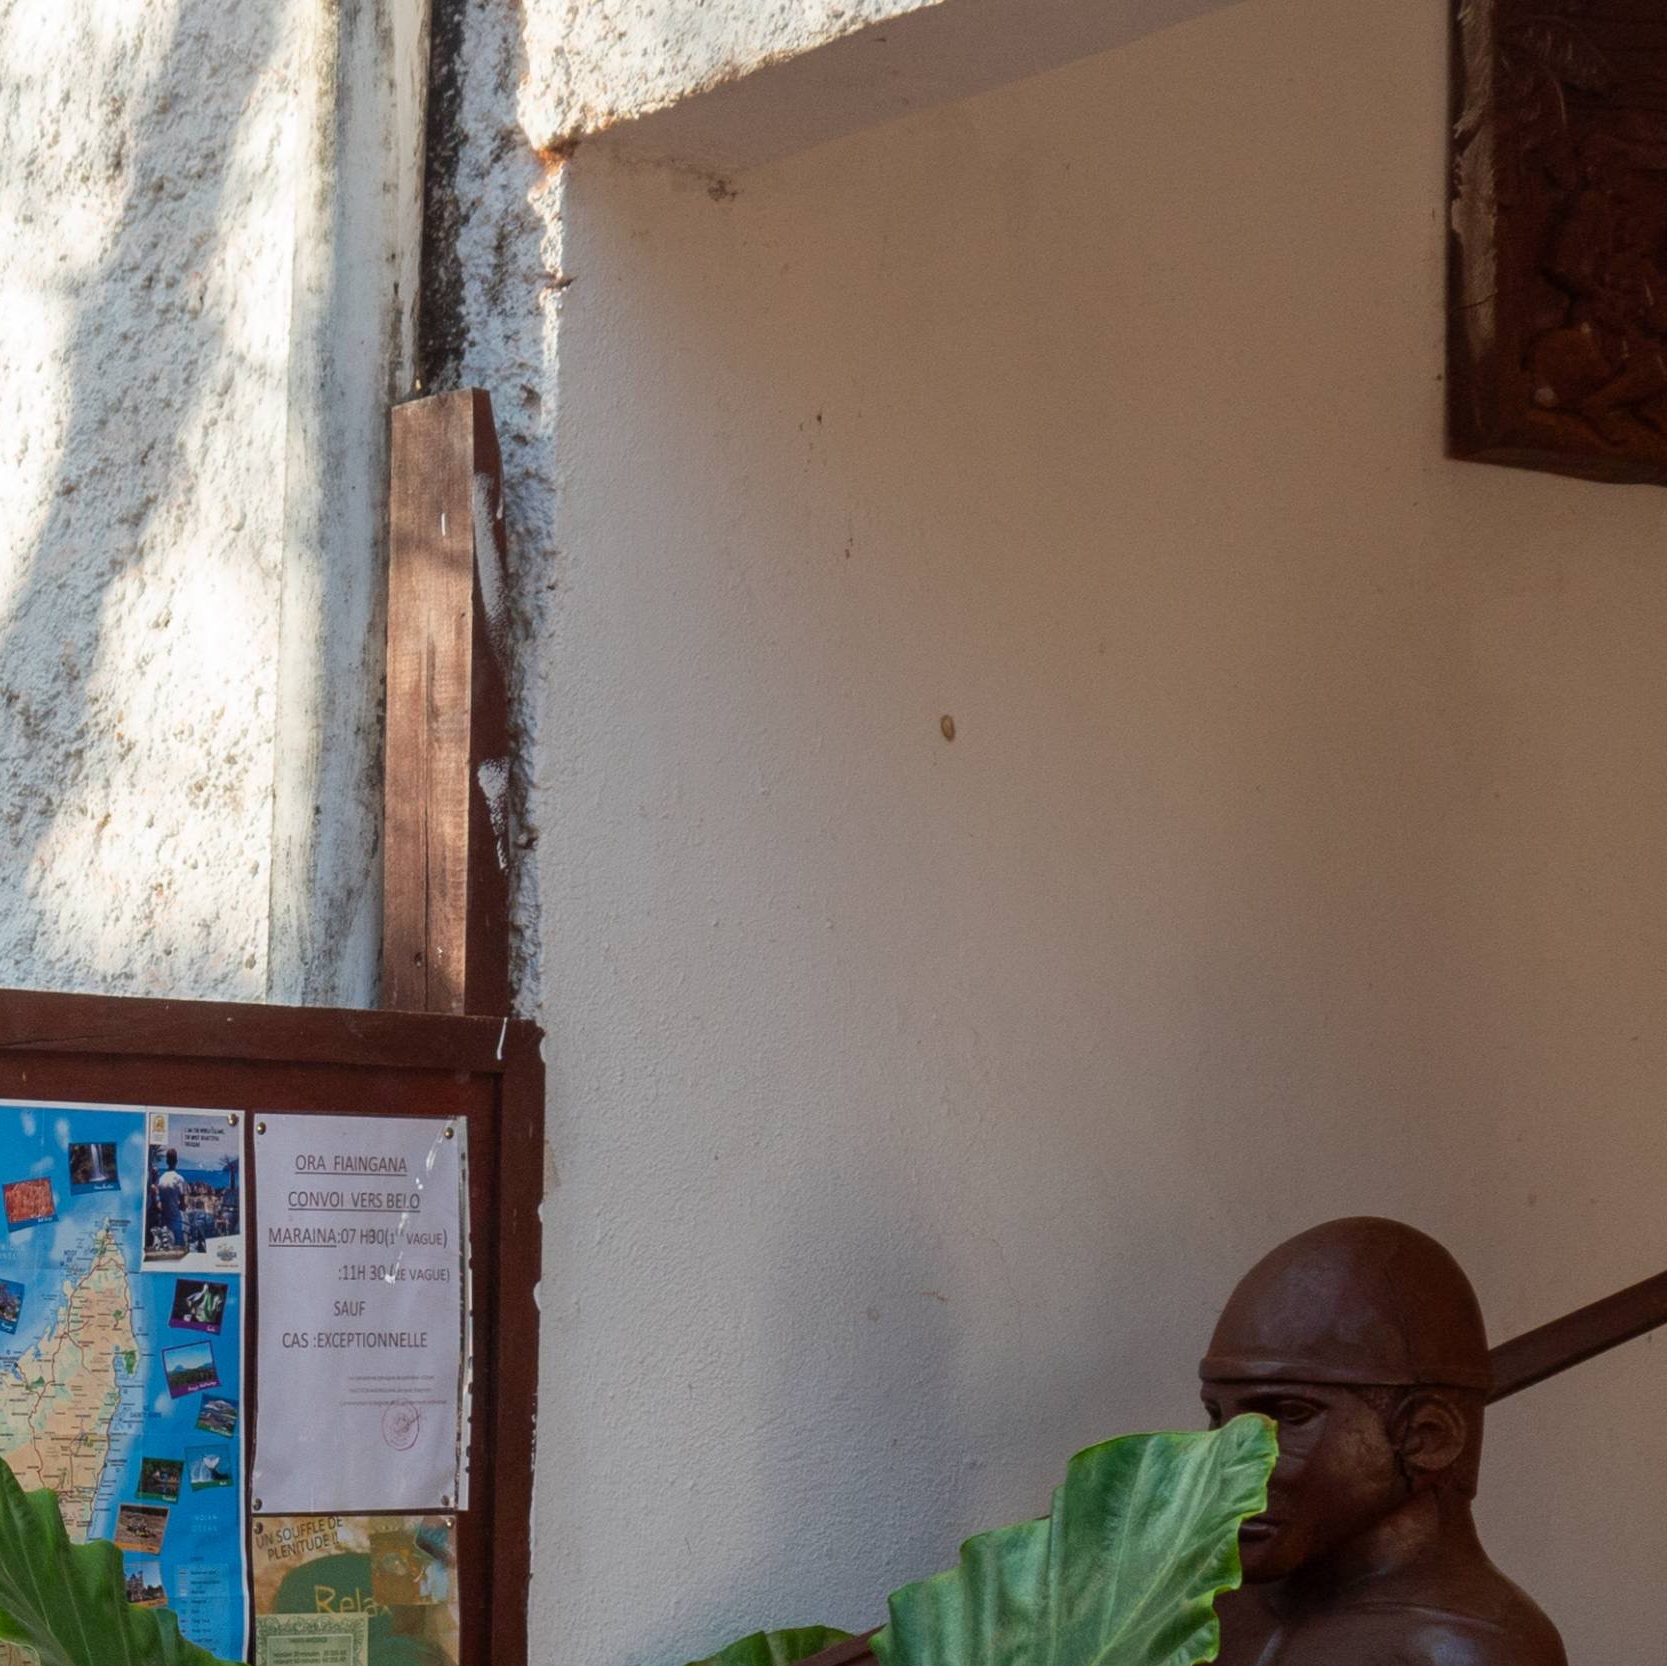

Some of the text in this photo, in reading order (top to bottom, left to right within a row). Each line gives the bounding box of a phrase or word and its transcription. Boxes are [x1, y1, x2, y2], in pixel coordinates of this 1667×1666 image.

[295, 1154, 408, 1172] ORA FIAINGANA
[288, 1191, 344, 1208] CONVOI
[351, 1192, 383, 1208] VERS
[406, 1228, 448, 1248] VAGUE)
[369, 1264, 386, 1280] 30
[409, 1268, 450, 1283] VAGUE)
[333, 1301, 366, 1316] SAUF
[282, 1332, 309, 1348] CAS
